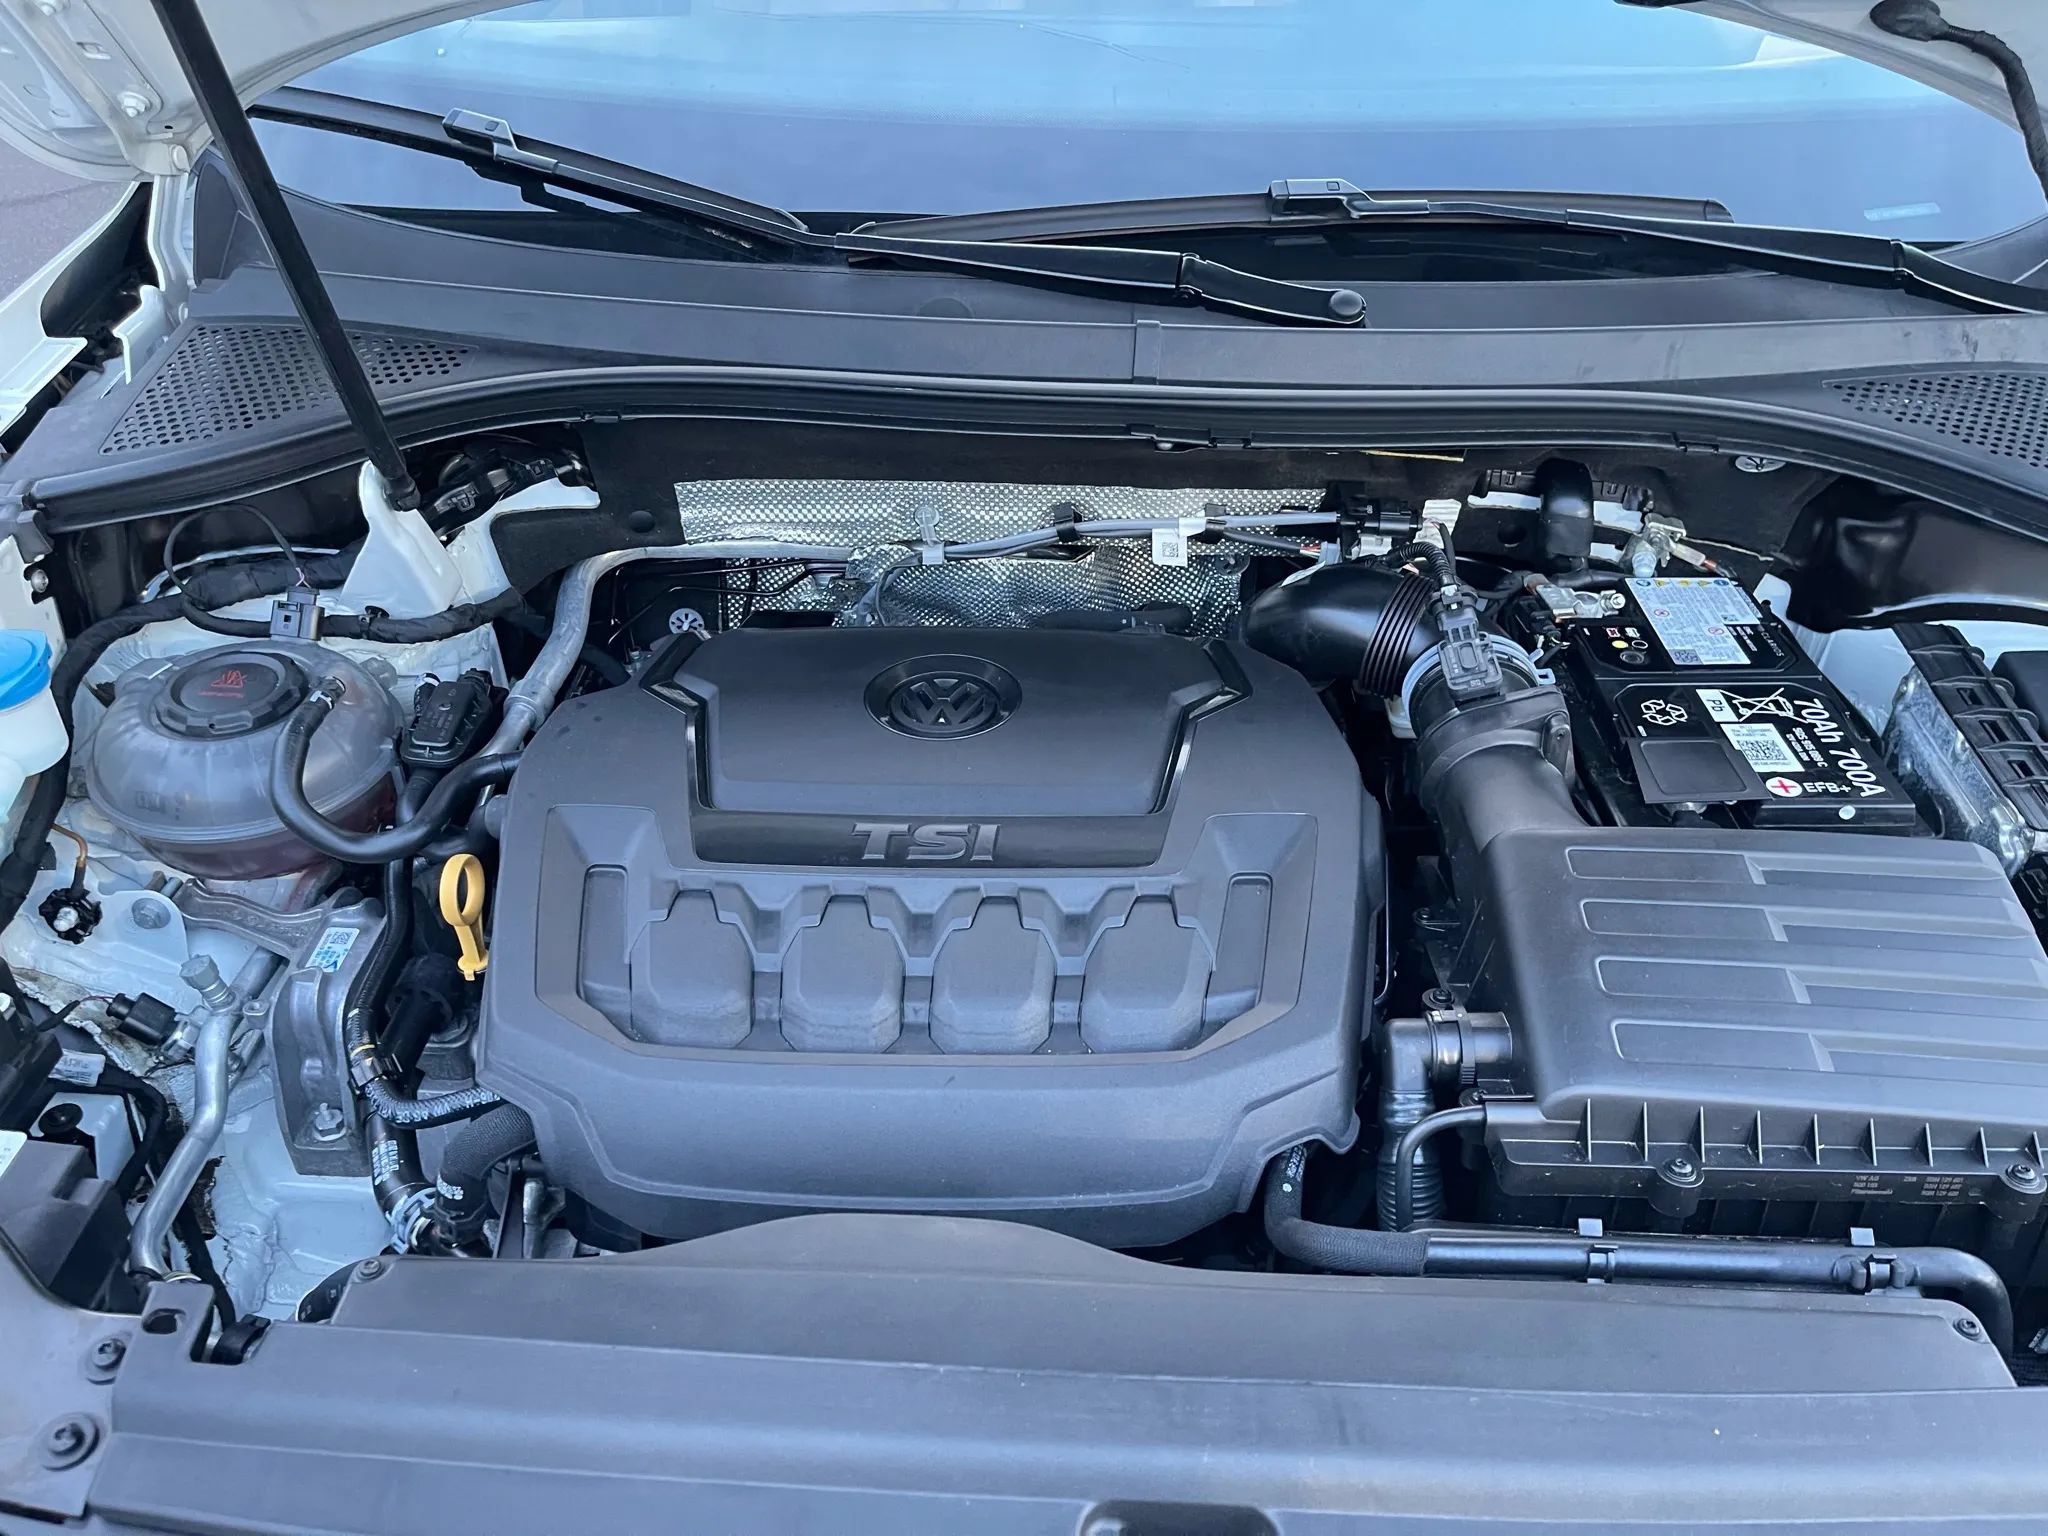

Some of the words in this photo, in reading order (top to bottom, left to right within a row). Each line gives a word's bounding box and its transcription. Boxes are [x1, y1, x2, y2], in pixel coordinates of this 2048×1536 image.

[1706, 699, 1726, 712] Pb
[1794, 698, 1844, 742] 70Ah
[1829, 748, 1886, 797] 700A
[1803, 782, 1852, 793] EFB+
[852, 822, 1001, 861] TSI
